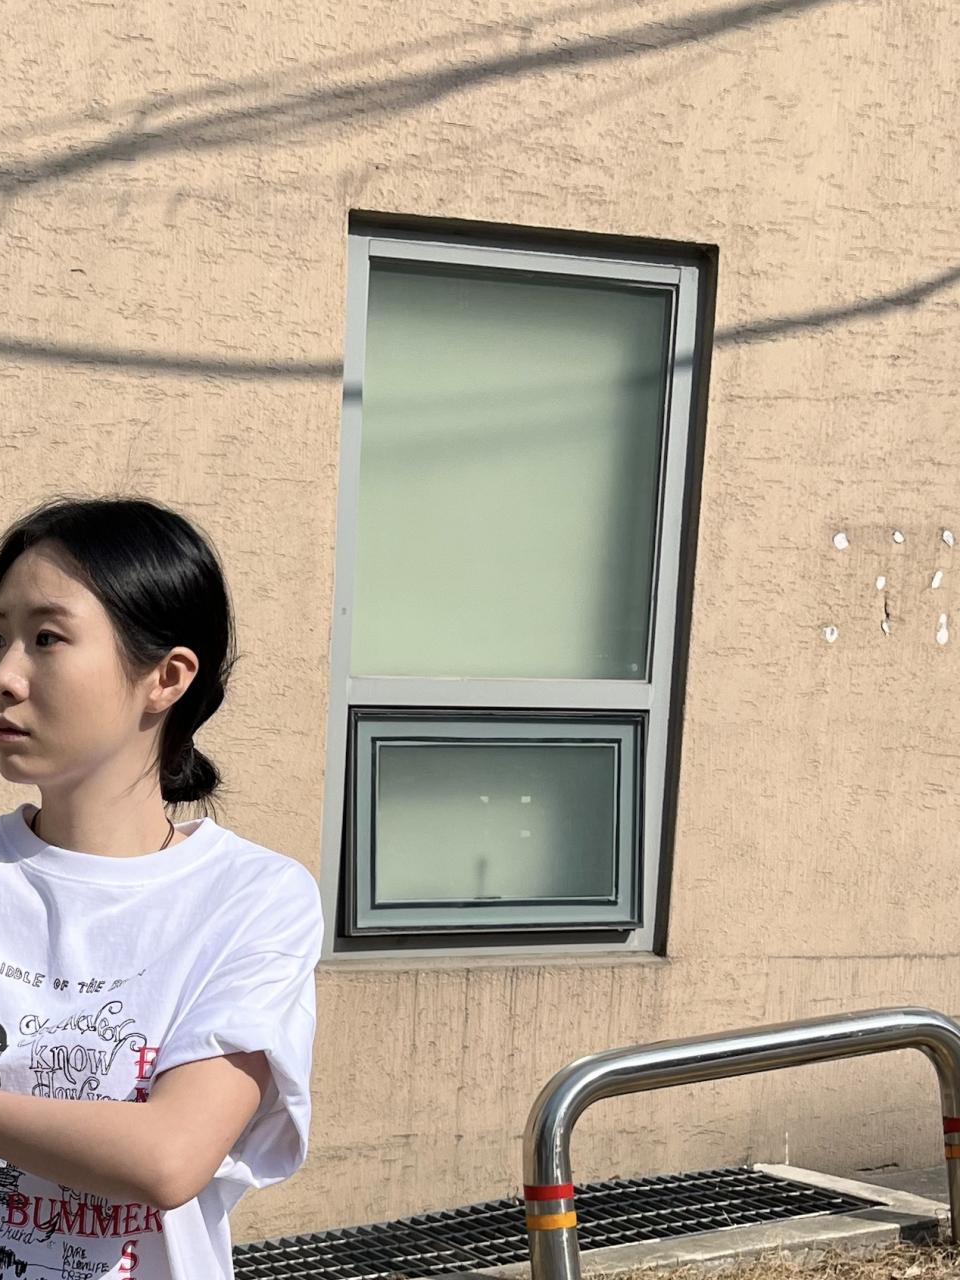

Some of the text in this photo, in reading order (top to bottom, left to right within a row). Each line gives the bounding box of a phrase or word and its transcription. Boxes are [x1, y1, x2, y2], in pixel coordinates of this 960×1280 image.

[53, 977, 69, 991] OF
[77, 977, 106, 993] THE
[6, 1191, 163, 1238] BUMMER
